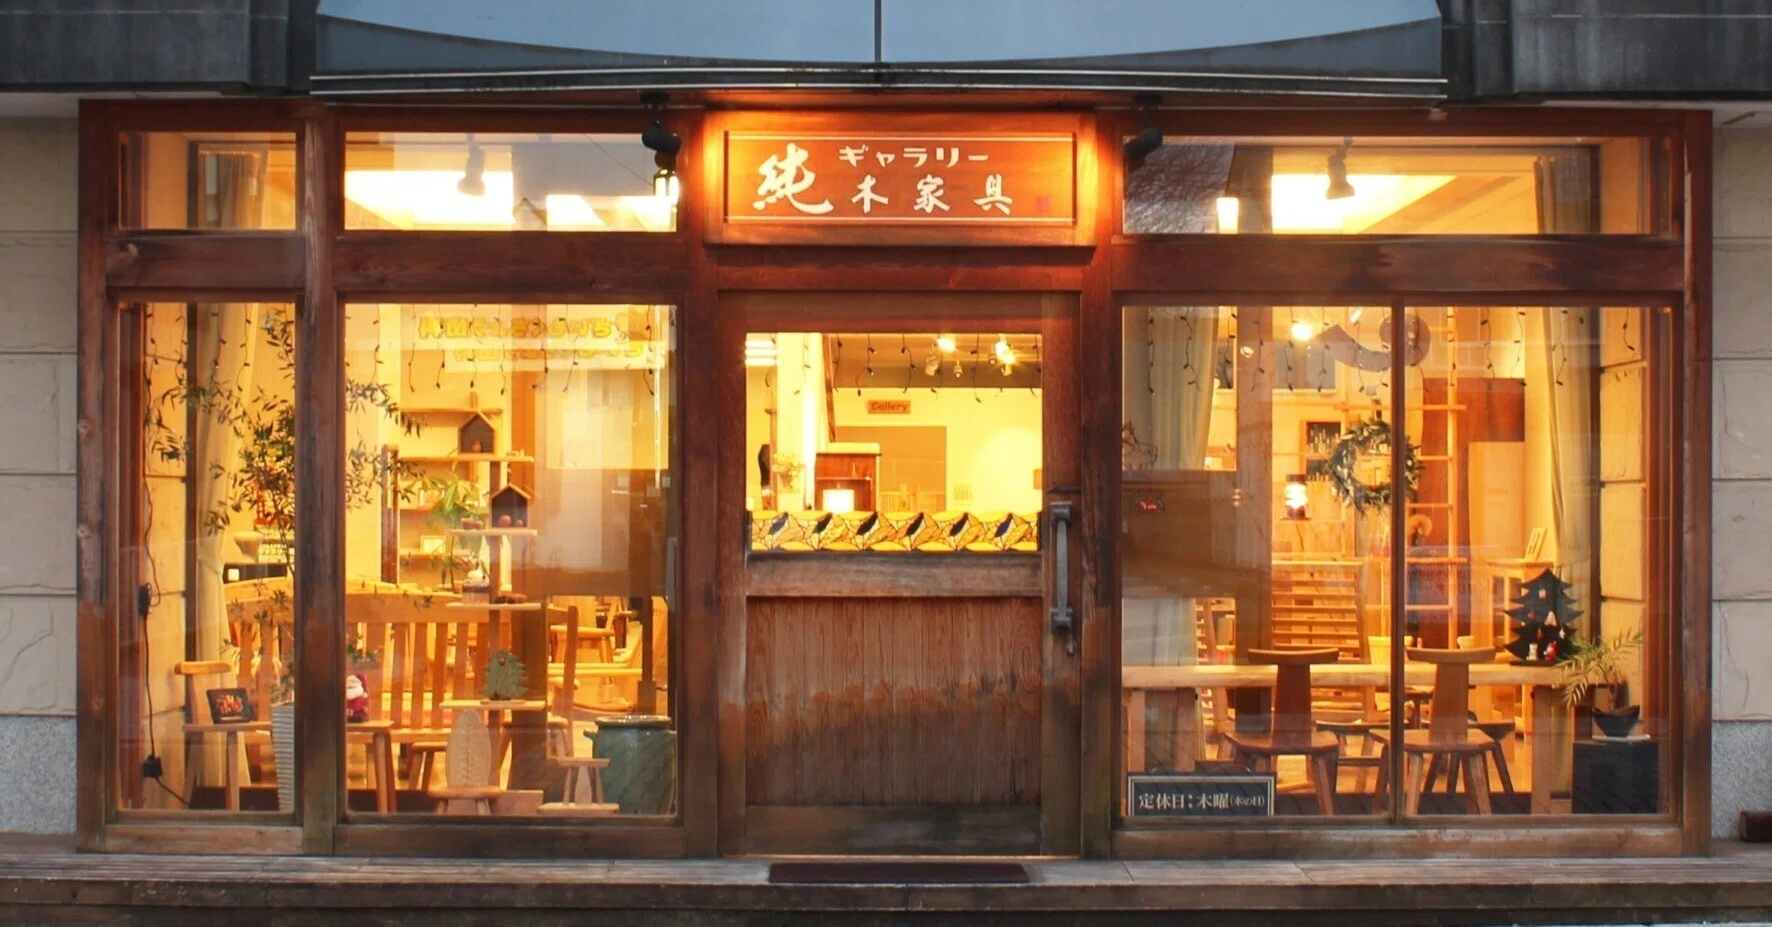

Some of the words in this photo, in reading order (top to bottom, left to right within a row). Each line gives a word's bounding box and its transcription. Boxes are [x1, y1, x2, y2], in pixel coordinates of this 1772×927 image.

[838, 144, 989, 168] ギャラリー
[871, 402, 908, 413] Gallery
